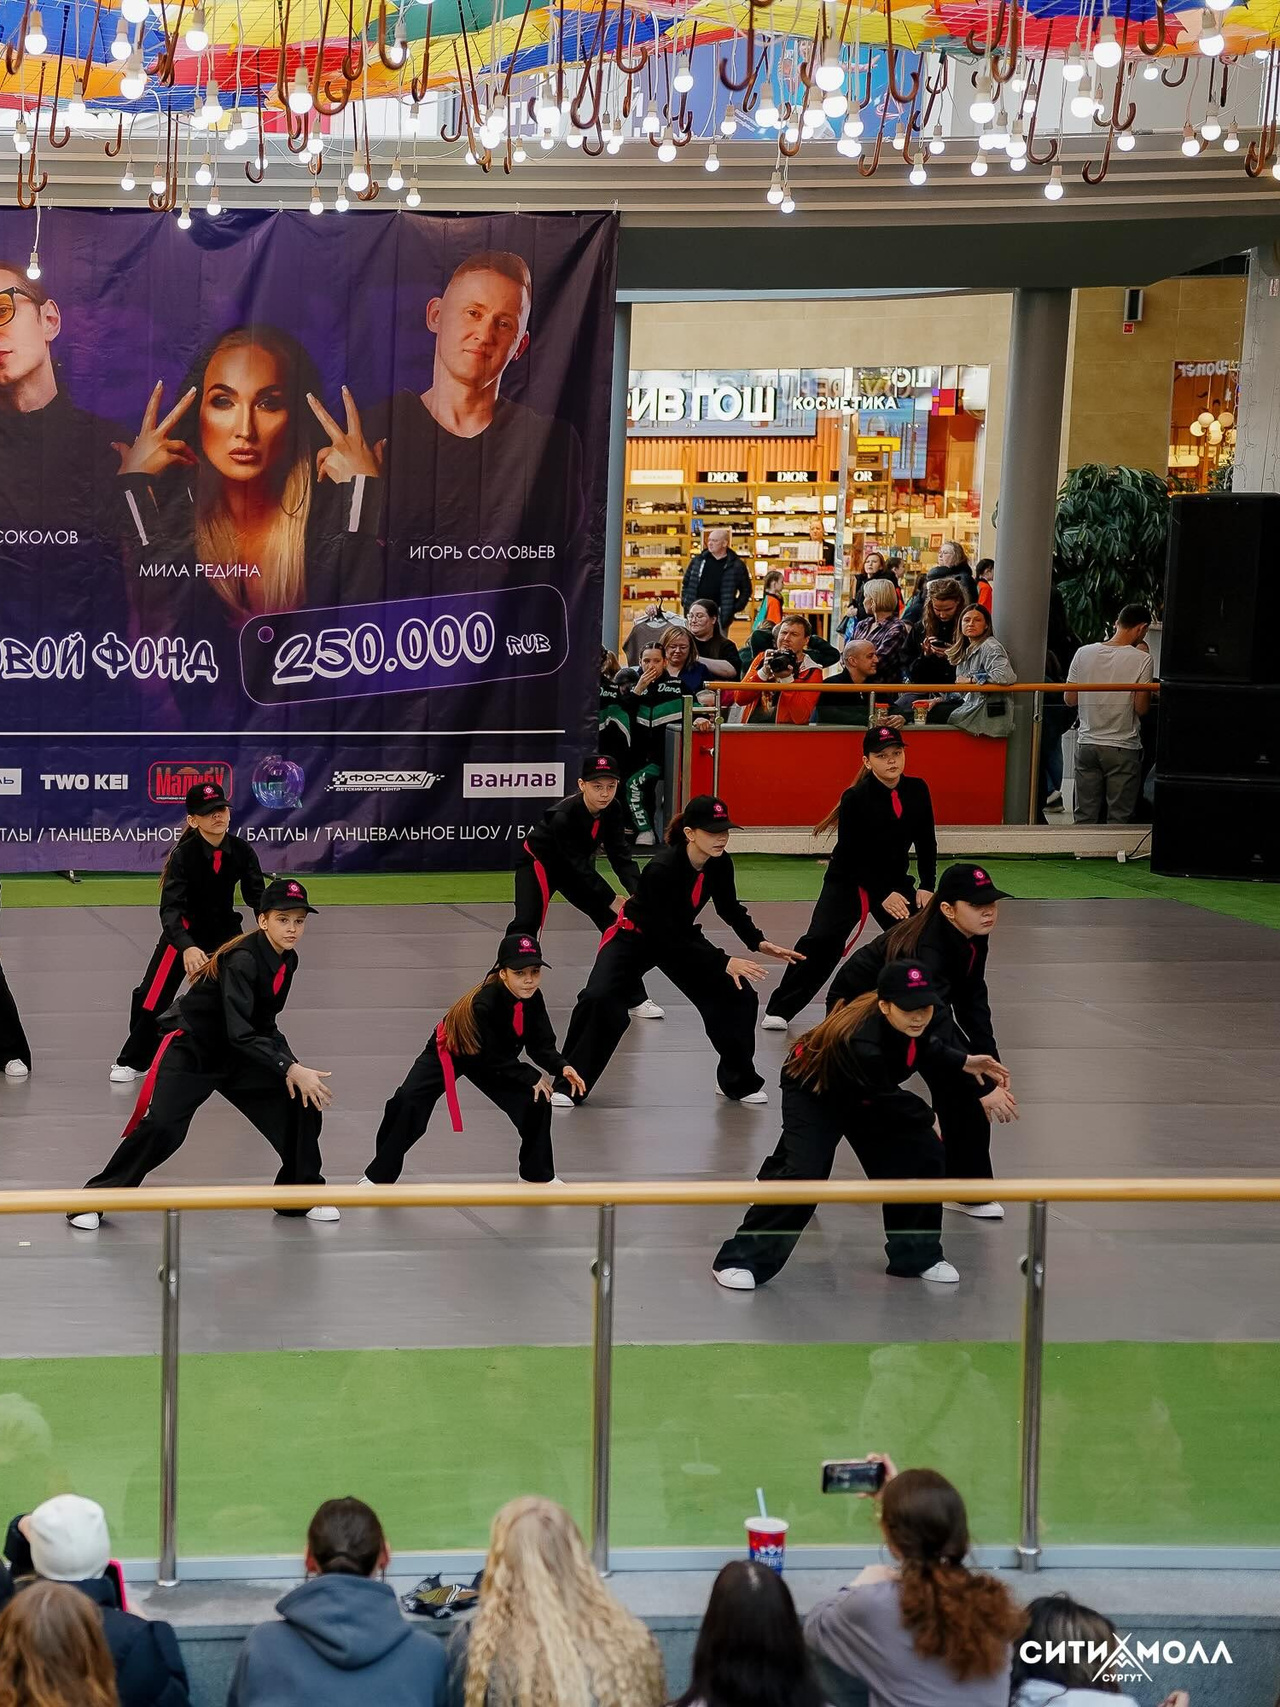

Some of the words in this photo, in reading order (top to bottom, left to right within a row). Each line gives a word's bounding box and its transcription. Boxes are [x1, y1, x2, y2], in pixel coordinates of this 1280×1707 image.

[693, 386, 777, 421] ГОШ
[792, 396, 898, 413] КОСМЕТИКА
[707, 471, 739, 483] DIOR
[777, 471, 808, 483] DIOR
[852, 471, 873, 482] OR
[410, 545, 462, 560] ИГОРЬ
[468, 545, 556, 560] СОЛОВЬЕВ
[139, 564, 190, 578] МИЛА
[195, 564, 261, 579] РЕДИНА
[272, 611, 495, 686] 250.000
[506, 634, 551, 655] RUB
[92, 632, 219, 683] ФОНД
[40, 774, 89, 790] TWO
[94, 774, 129, 790] KEI
[348, 774, 422, 783] ФОРСАЖ
[470, 773, 557, 788] ванлав
[48, 827, 181, 843] ТАНЦЕВАЛЬНОЕ
[247, 827, 308, 841] БАТТЛЫ
[325, 826, 455, 843] ТАНЦЕВАЛЬНОЕ
[460, 825, 501, 841] ШОУ
